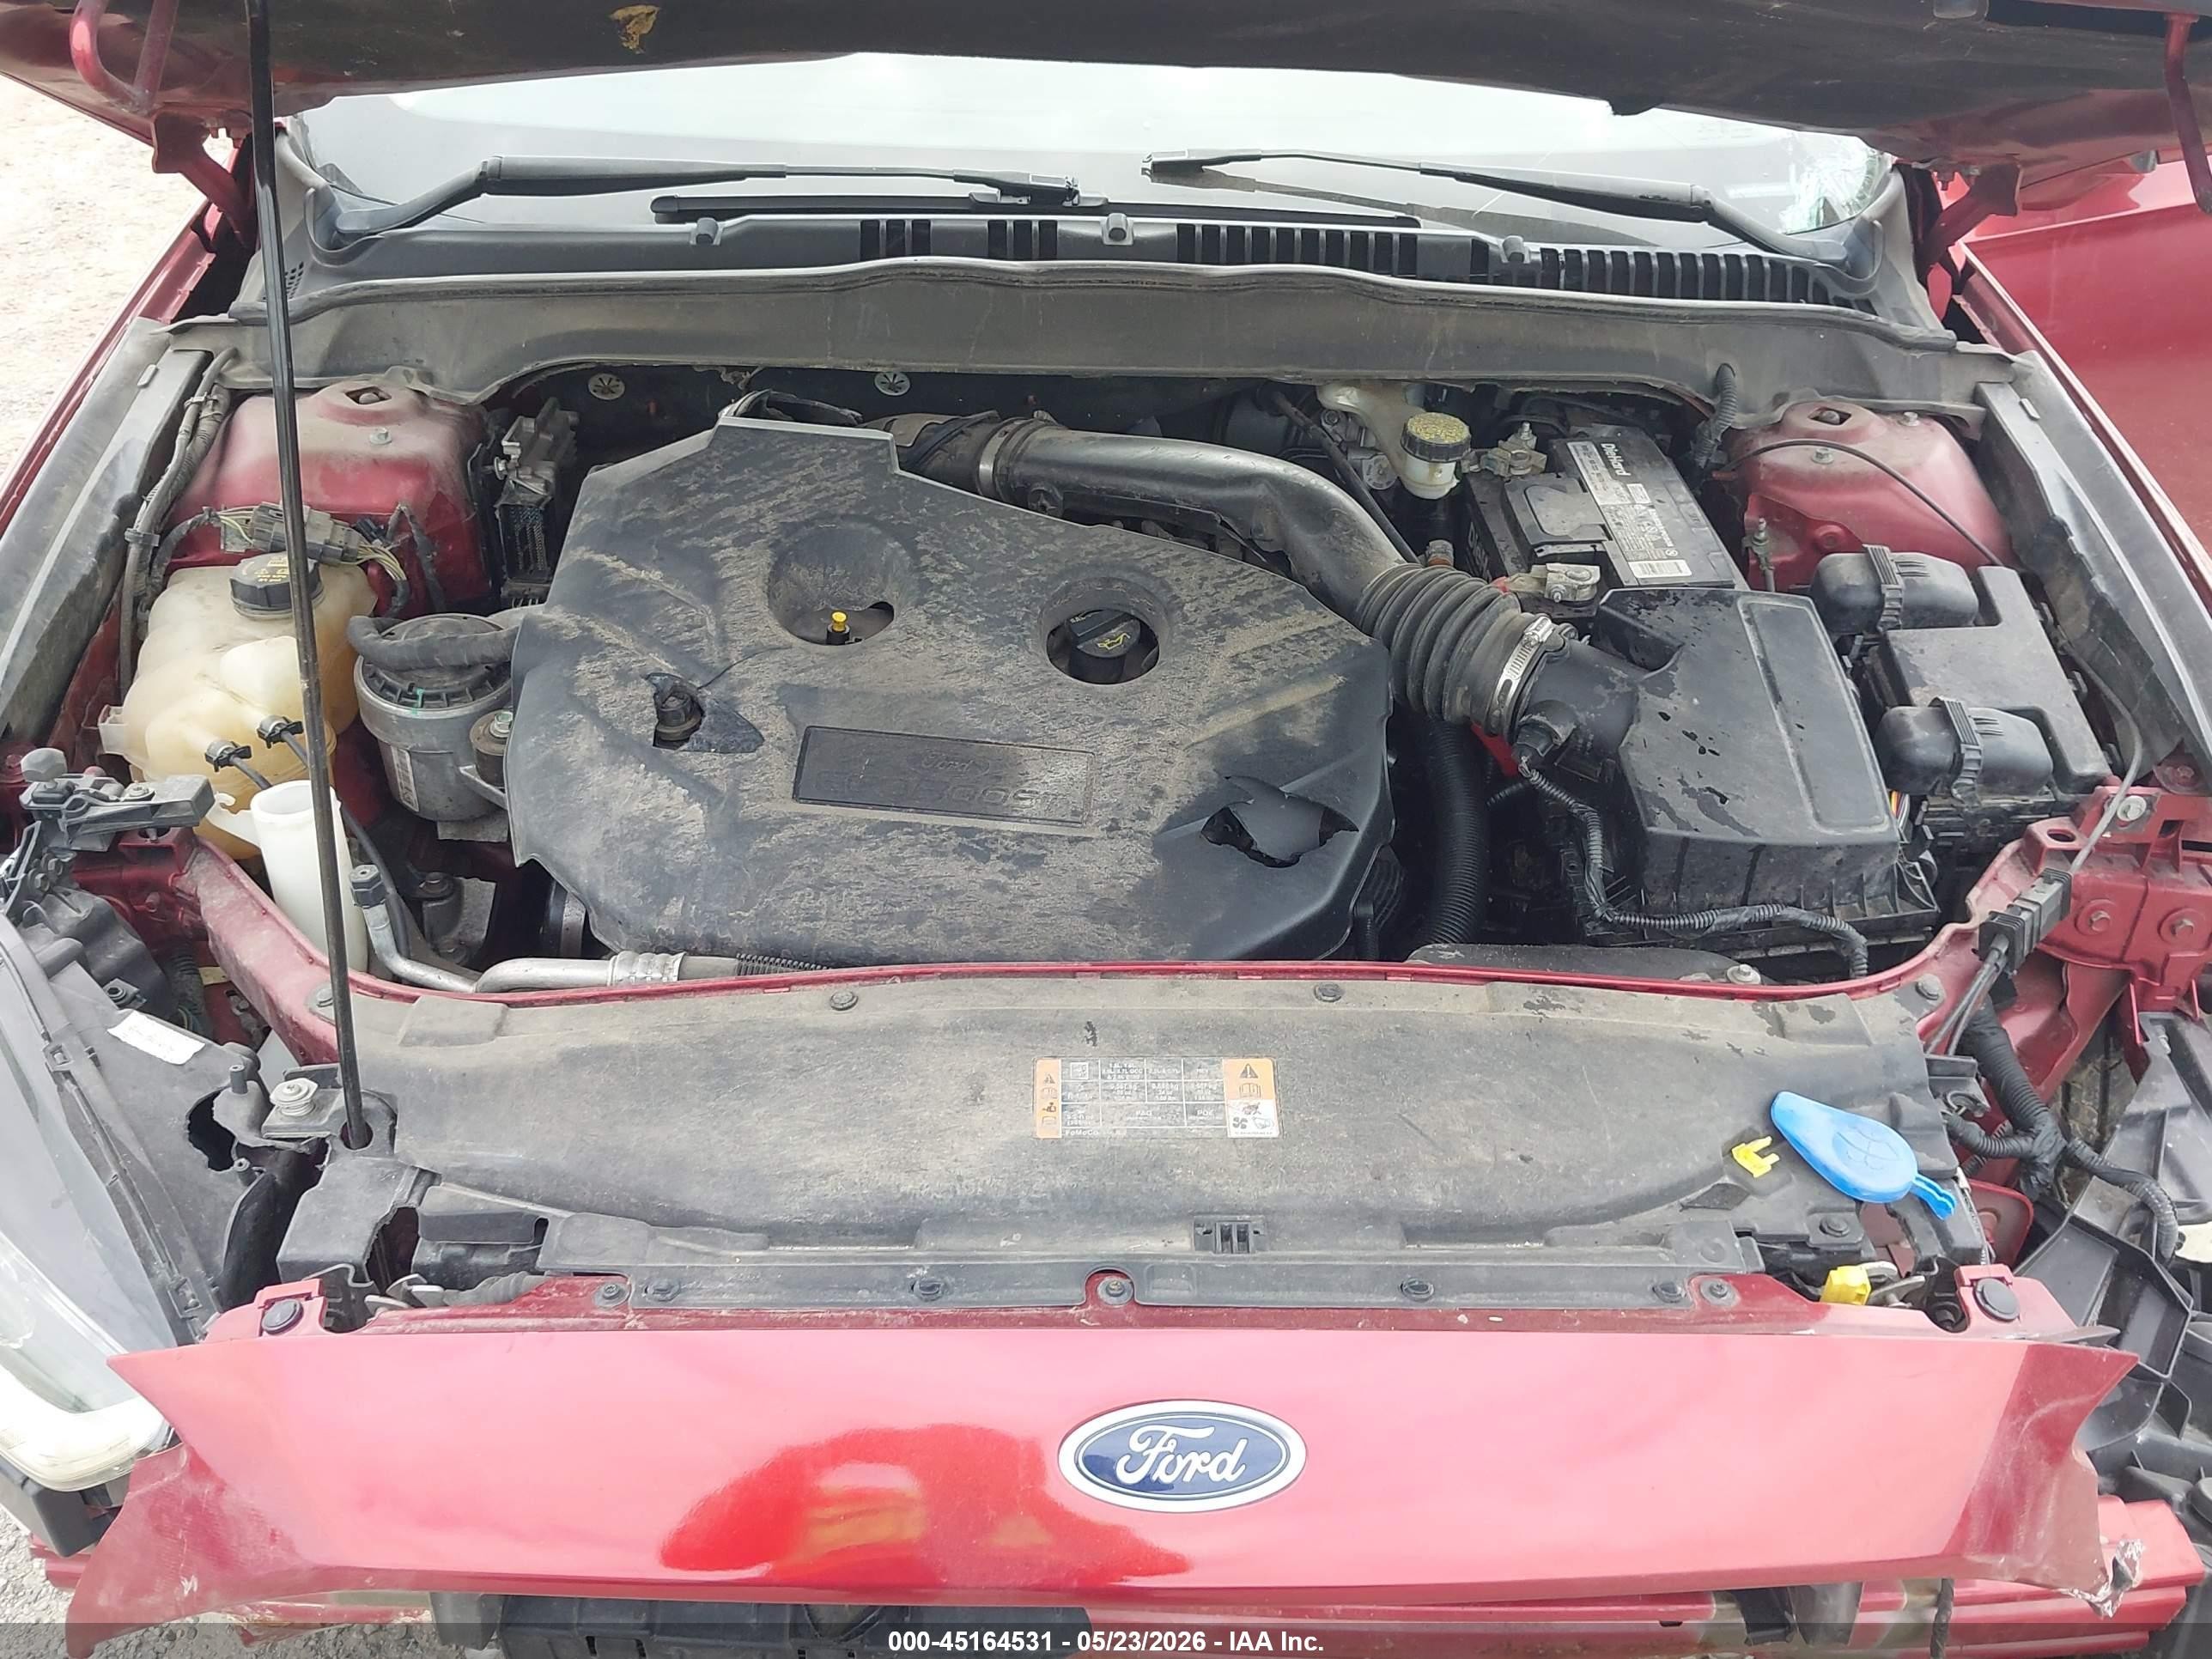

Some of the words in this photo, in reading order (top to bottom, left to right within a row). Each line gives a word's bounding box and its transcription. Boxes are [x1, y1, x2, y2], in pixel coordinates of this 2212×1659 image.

[1600, 442, 1632, 477] DieHard
[919, 752, 975, 773] Ford
[1115, 1424, 1249, 1485] Ford
